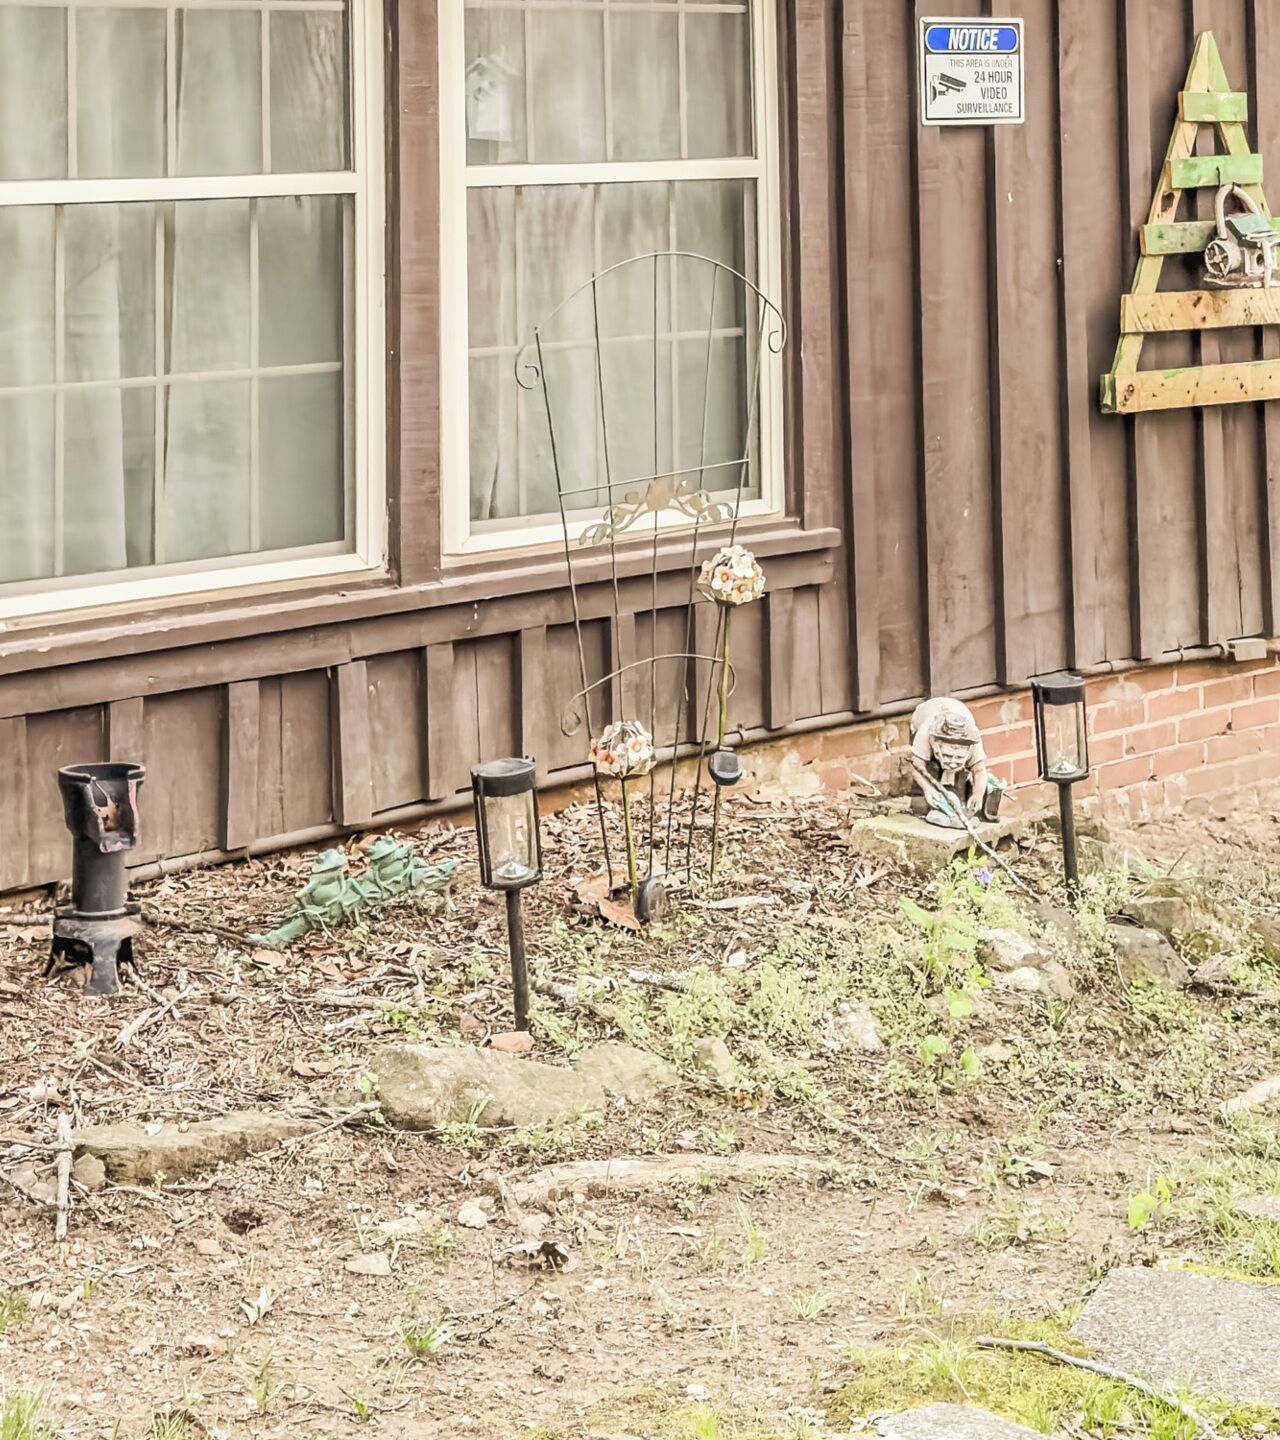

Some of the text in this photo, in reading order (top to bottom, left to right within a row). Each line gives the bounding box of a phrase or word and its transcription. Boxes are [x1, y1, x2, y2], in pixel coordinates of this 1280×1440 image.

[948, 28, 1000, 50] NOTICE
[950, 59, 1013, 68] THIS AREA IS UNDER
[974, 71, 1013, 83] 24 HOUR
[980, 87, 1008, 100] VIDEO
[956, 102, 1013, 114] SURVEILLANCE
